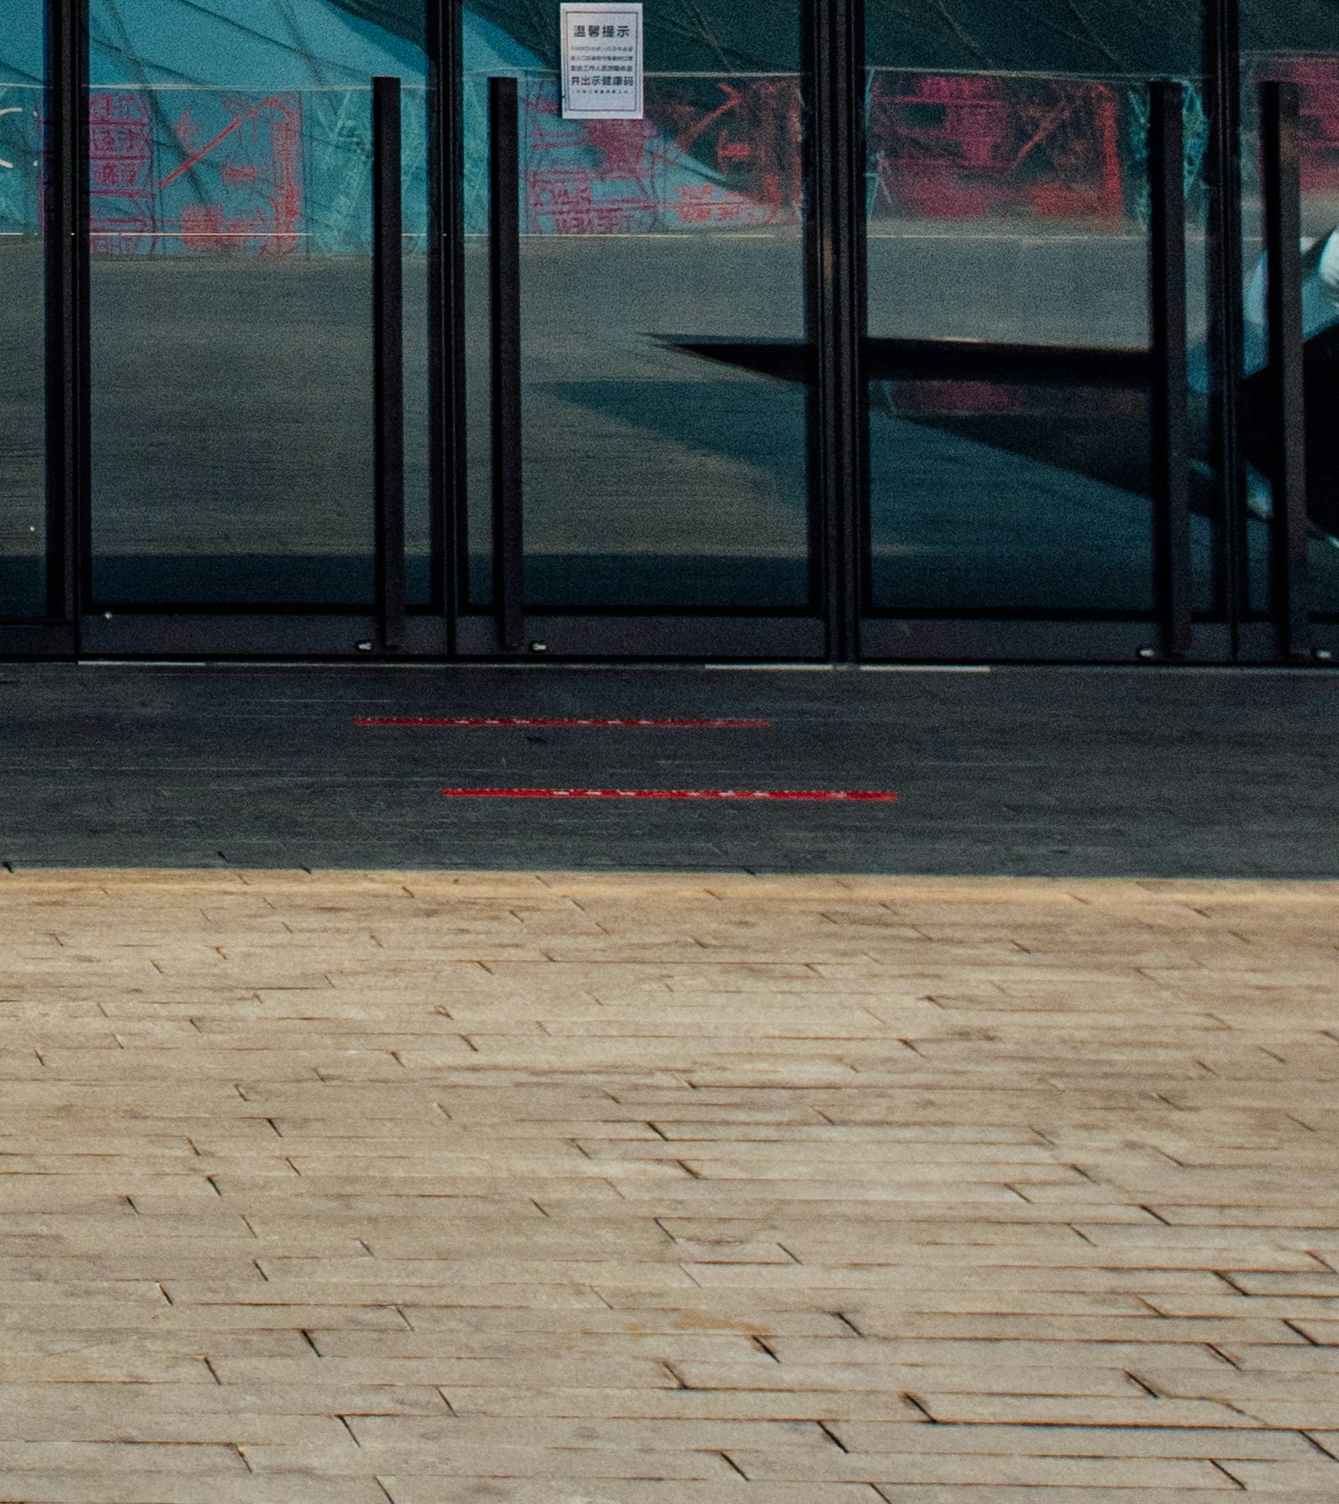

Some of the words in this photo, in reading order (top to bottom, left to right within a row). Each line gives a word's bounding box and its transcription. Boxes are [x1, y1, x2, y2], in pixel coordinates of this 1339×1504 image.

[573, 24, 630, 38] 温馨提示
[570, 76, 634, 87] 并出示健康码
